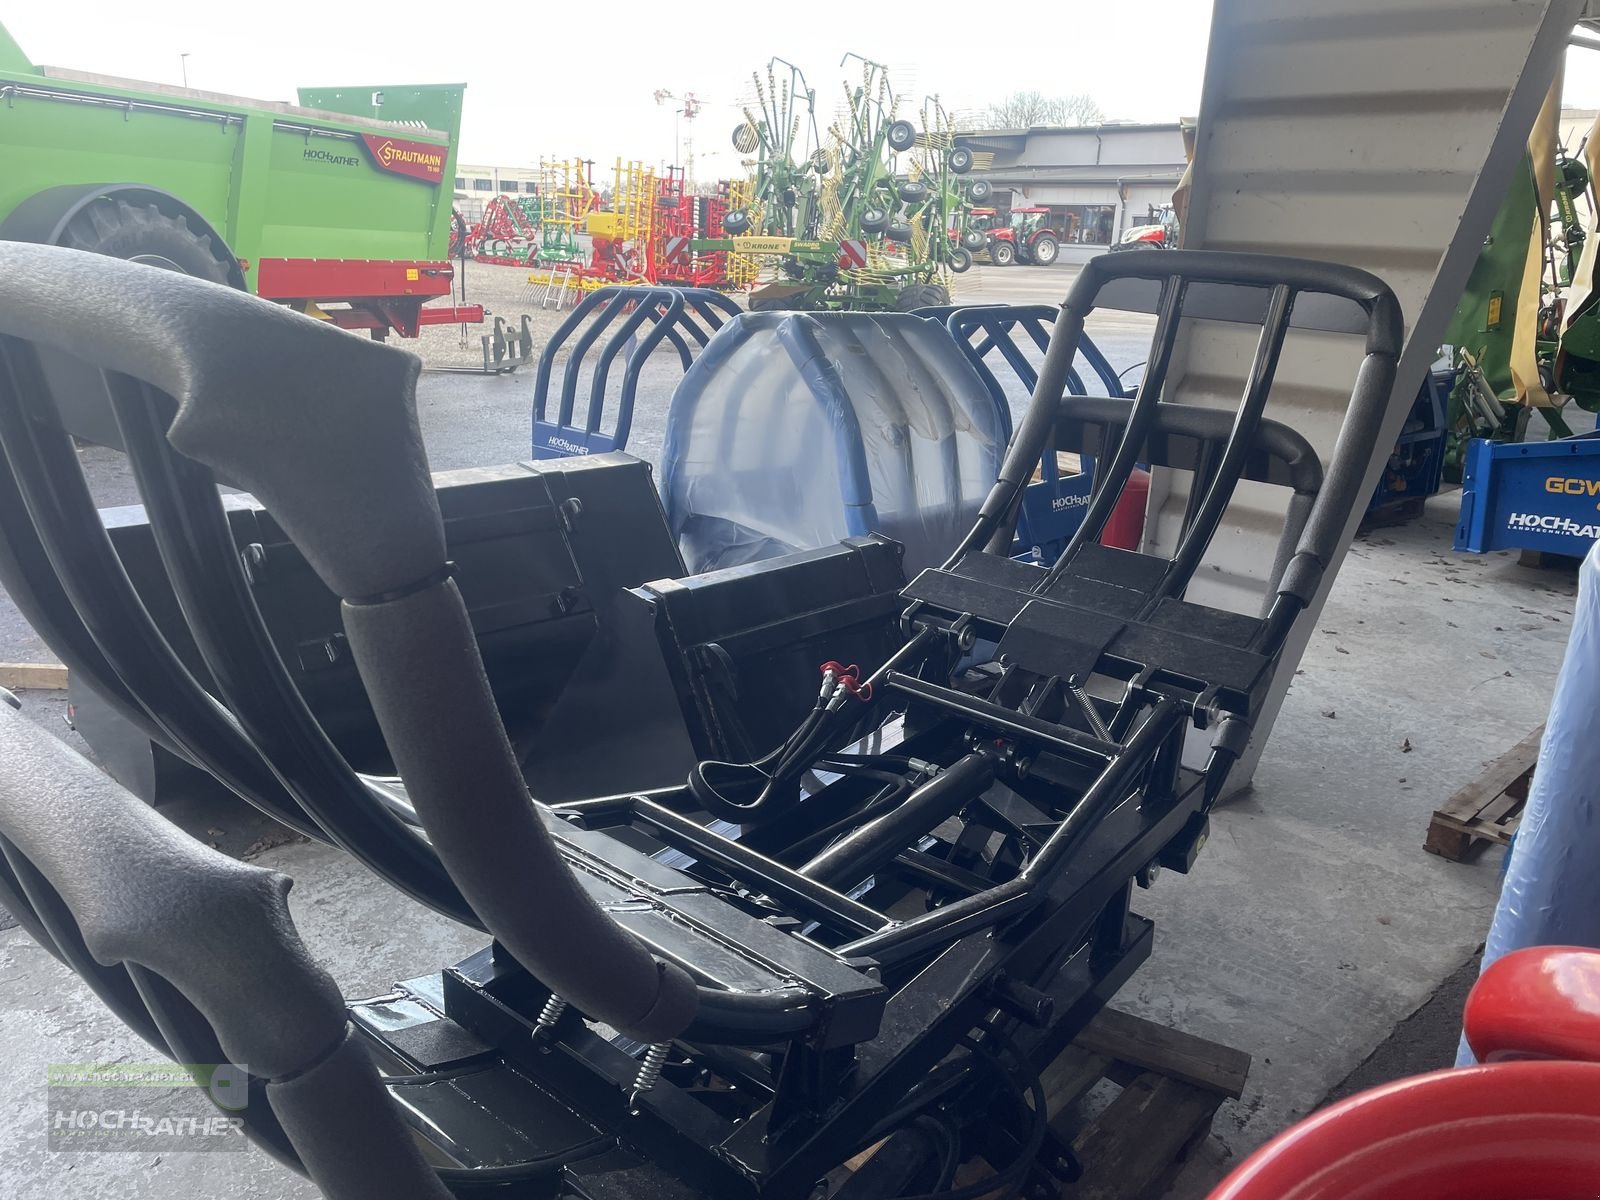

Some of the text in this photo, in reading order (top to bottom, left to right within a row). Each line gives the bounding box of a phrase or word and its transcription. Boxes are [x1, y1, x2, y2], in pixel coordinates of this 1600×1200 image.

[303, 149, 359, 166] HOCHRATHER
[383, 146, 441, 166] STRAUTMANN
[548, 435, 589, 456] HOCHRATHER
[1507, 525, 1571, 536] LANDTECHNIK
